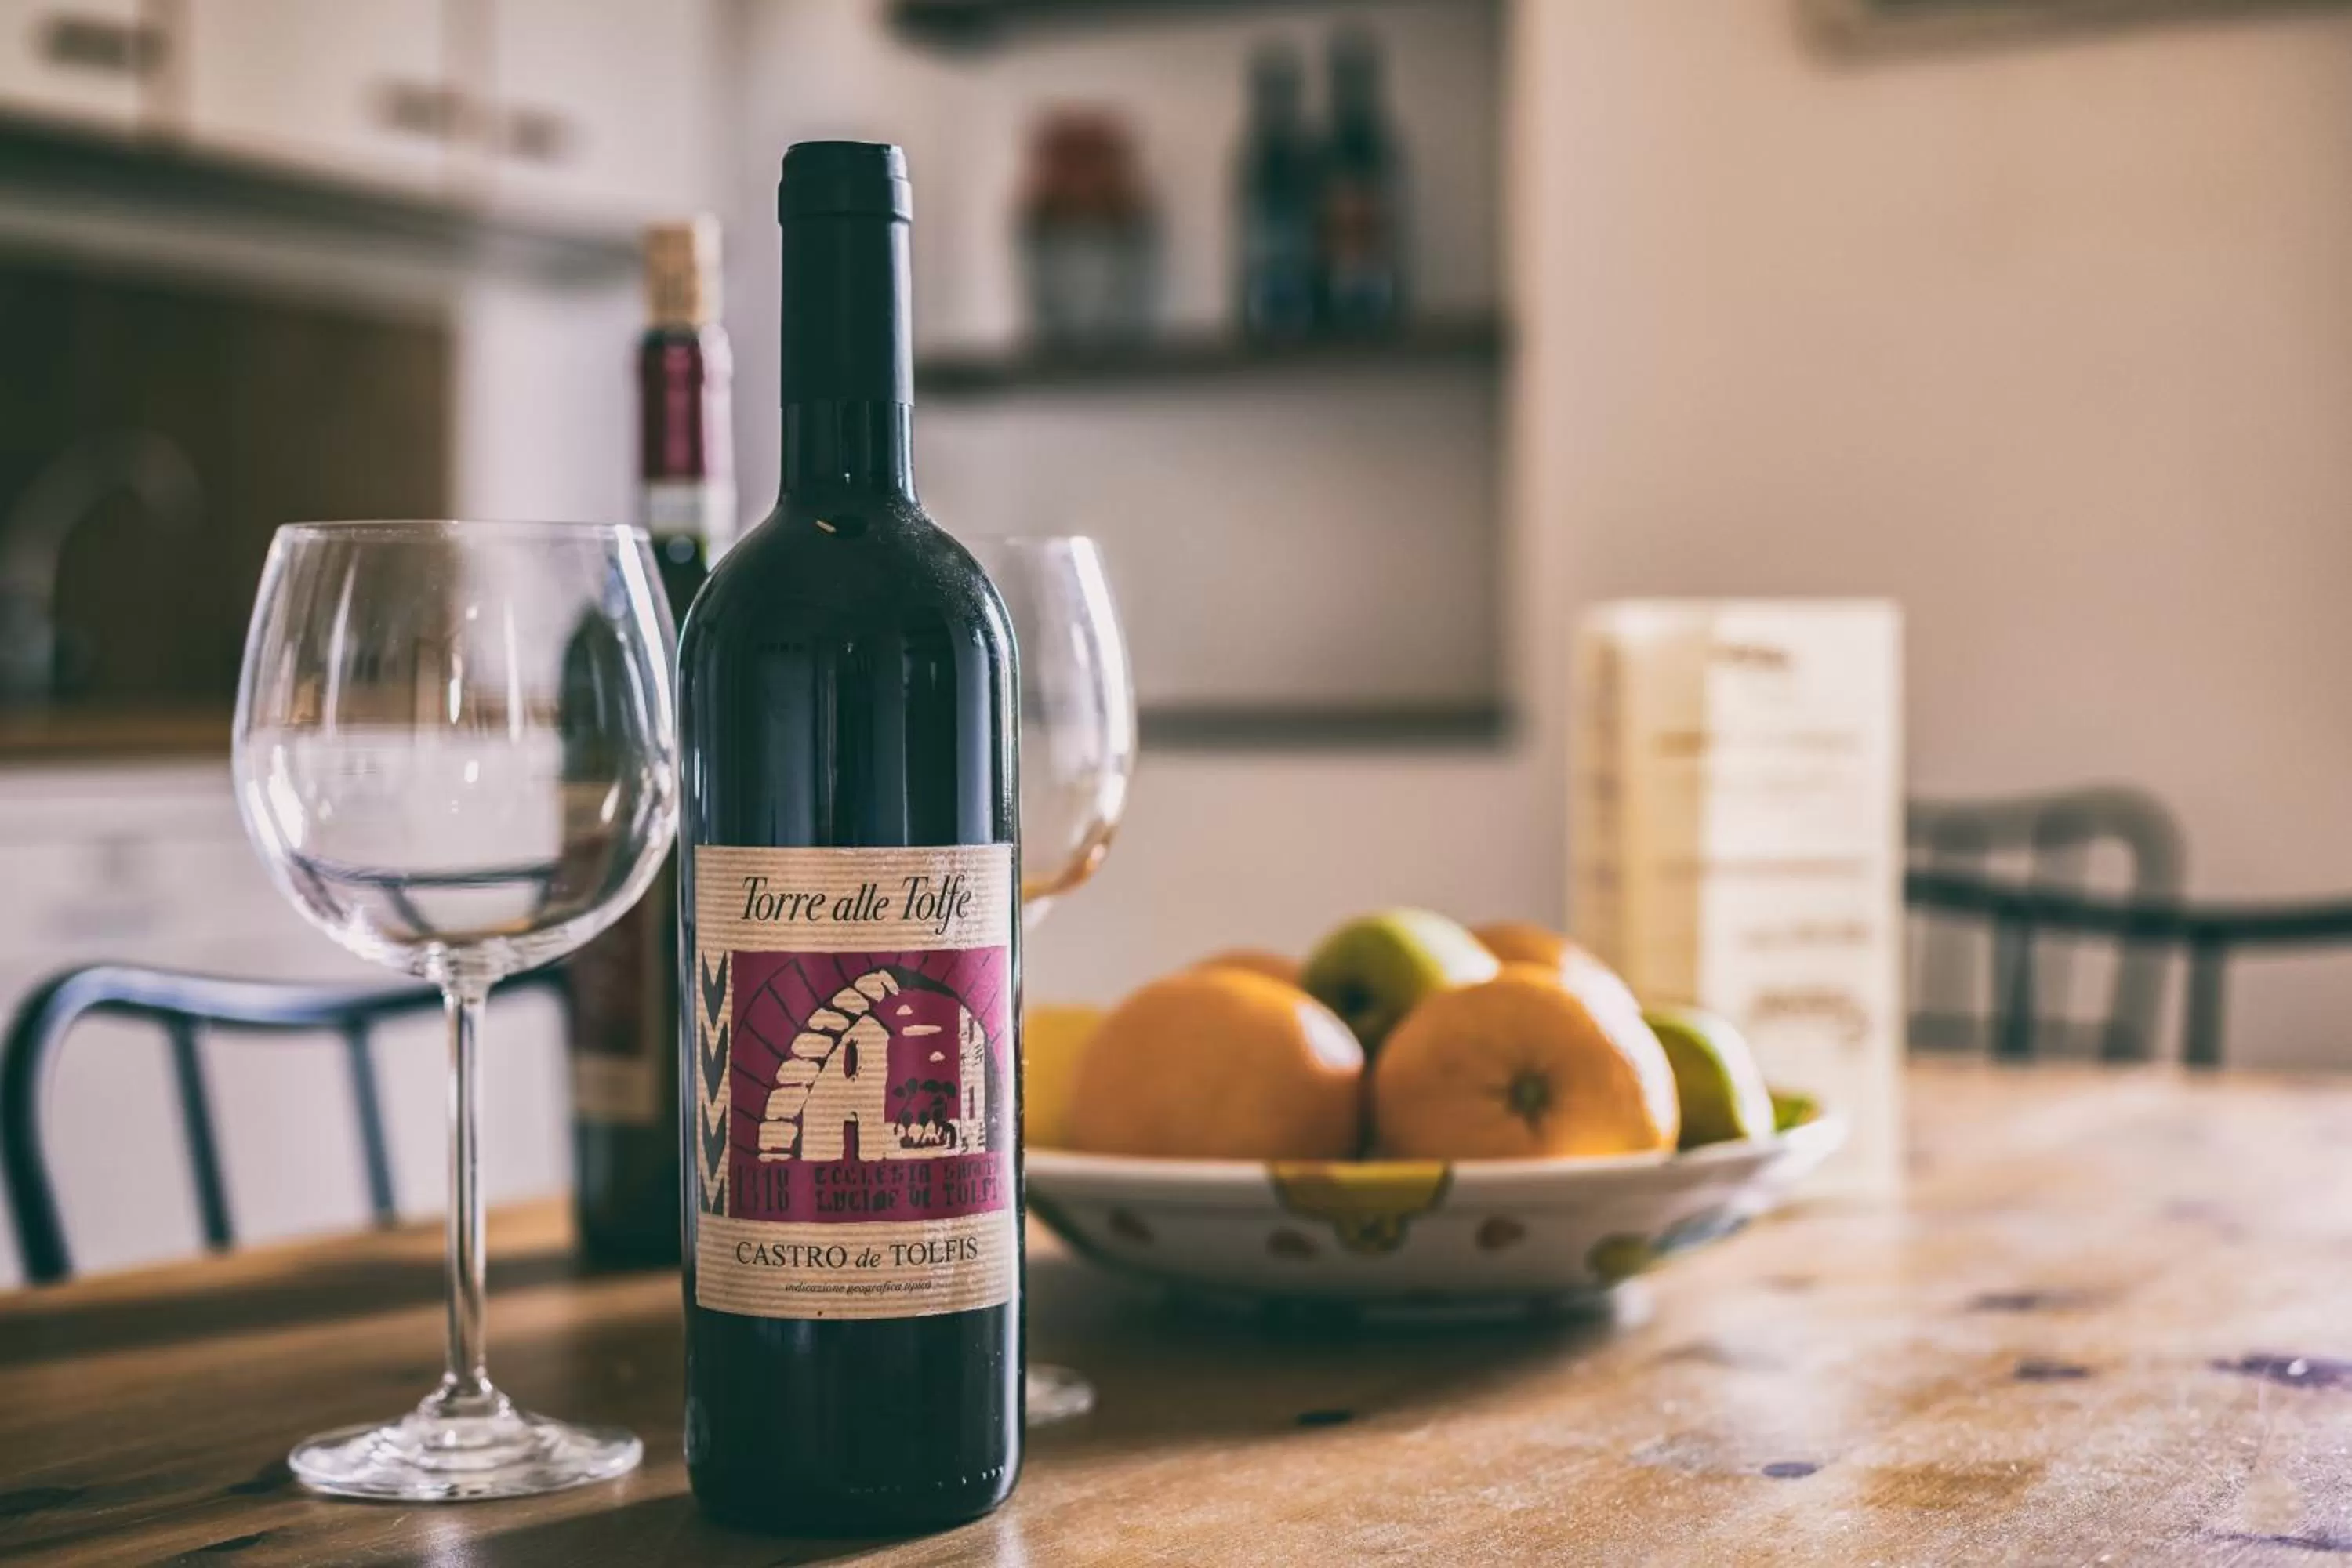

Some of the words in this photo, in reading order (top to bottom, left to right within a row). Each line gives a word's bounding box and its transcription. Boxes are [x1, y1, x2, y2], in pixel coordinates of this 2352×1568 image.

[740, 876, 827, 921] Torre
[832, 883, 890, 921] alle
[901, 874, 972, 935] Tolfe
[735, 1241, 848, 1268] CASTRO
[855, 1250, 881, 1268] de
[888, 1236, 979, 1267] TOLFIS
[785, 1281, 846, 1294] indicazione
[846, 1280, 902, 1297] geografica
